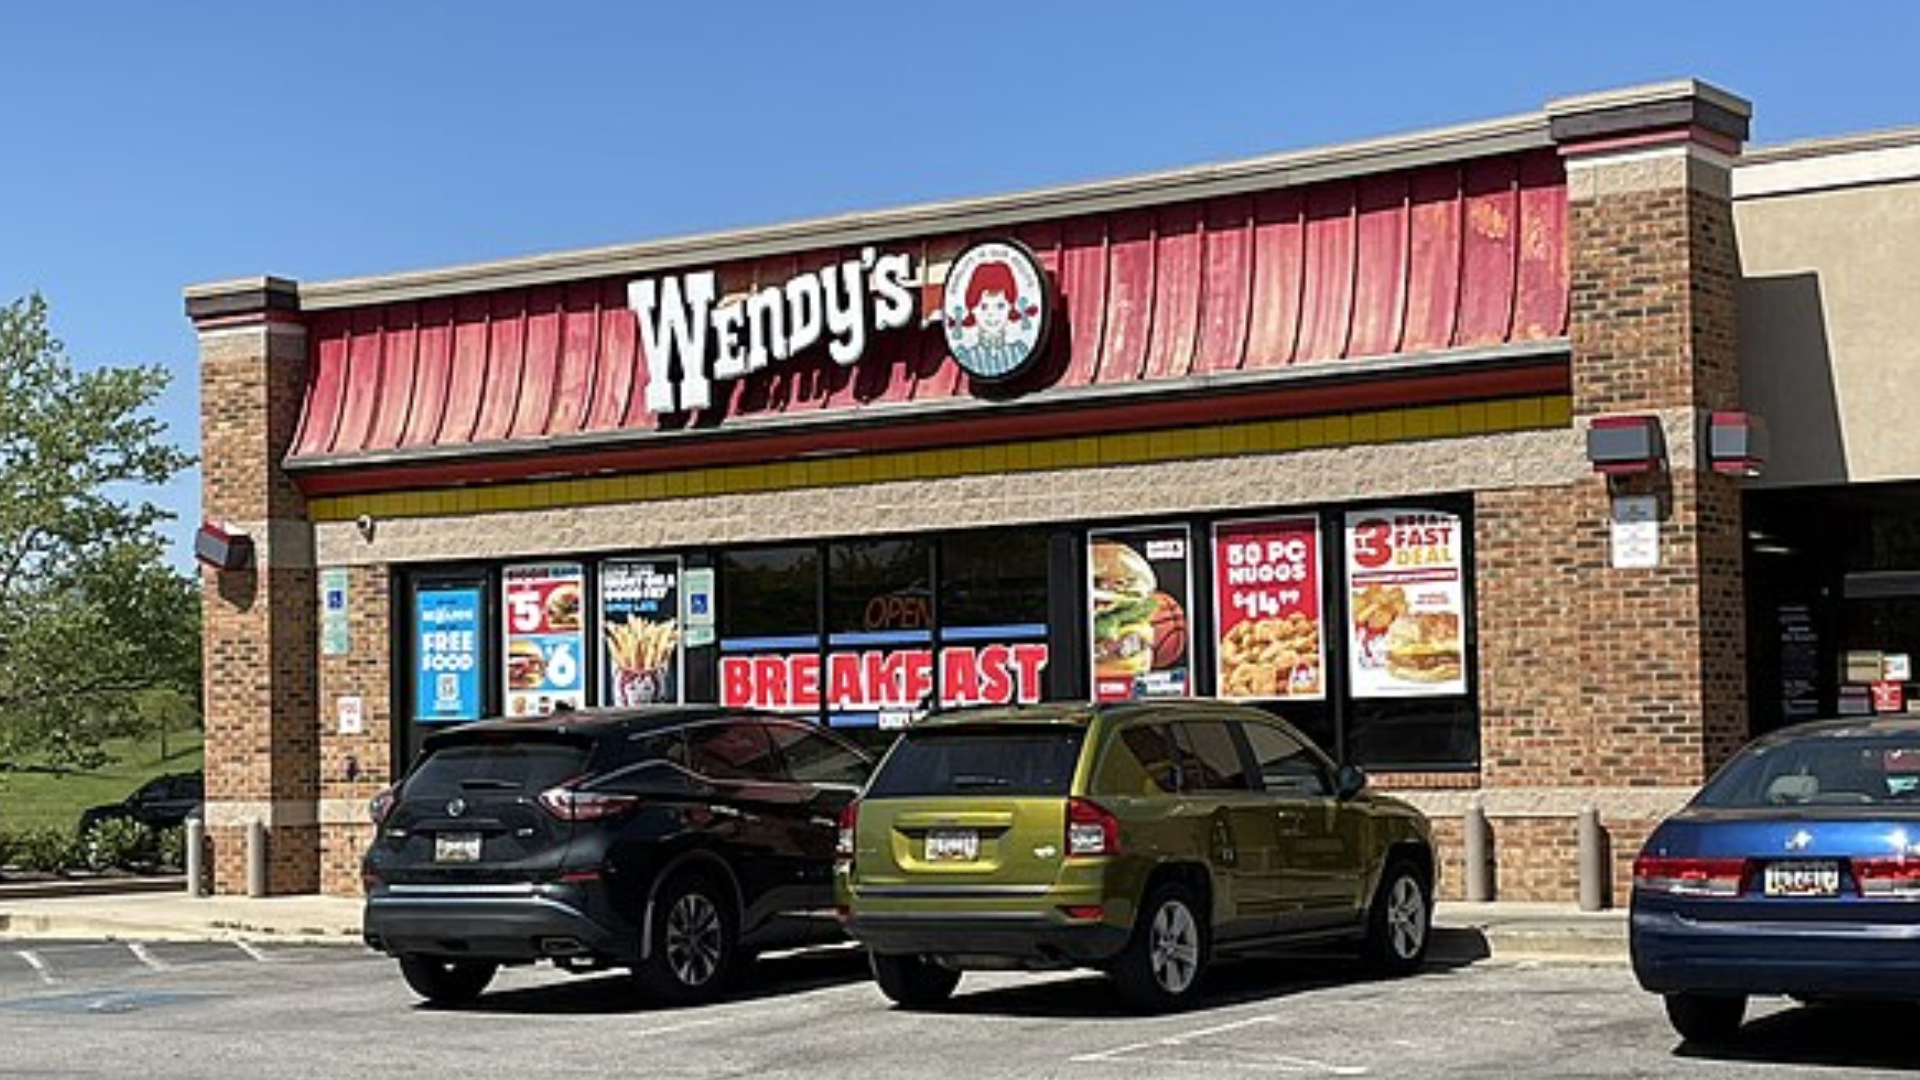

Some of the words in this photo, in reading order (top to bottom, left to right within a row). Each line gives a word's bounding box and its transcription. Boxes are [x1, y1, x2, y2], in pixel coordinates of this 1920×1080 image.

[1395, 527, 1453, 549] FAST
[1228, 542, 1261, 566] 50
[1268, 540, 1307, 563] PC
[1395, 546, 1454, 567] DEAL
[866, 595, 932, 629] OPEN
[422, 631, 475, 652] FREE
[422, 653, 475, 672] FOOD
[719, 643, 1049, 710] BREAKFAST
